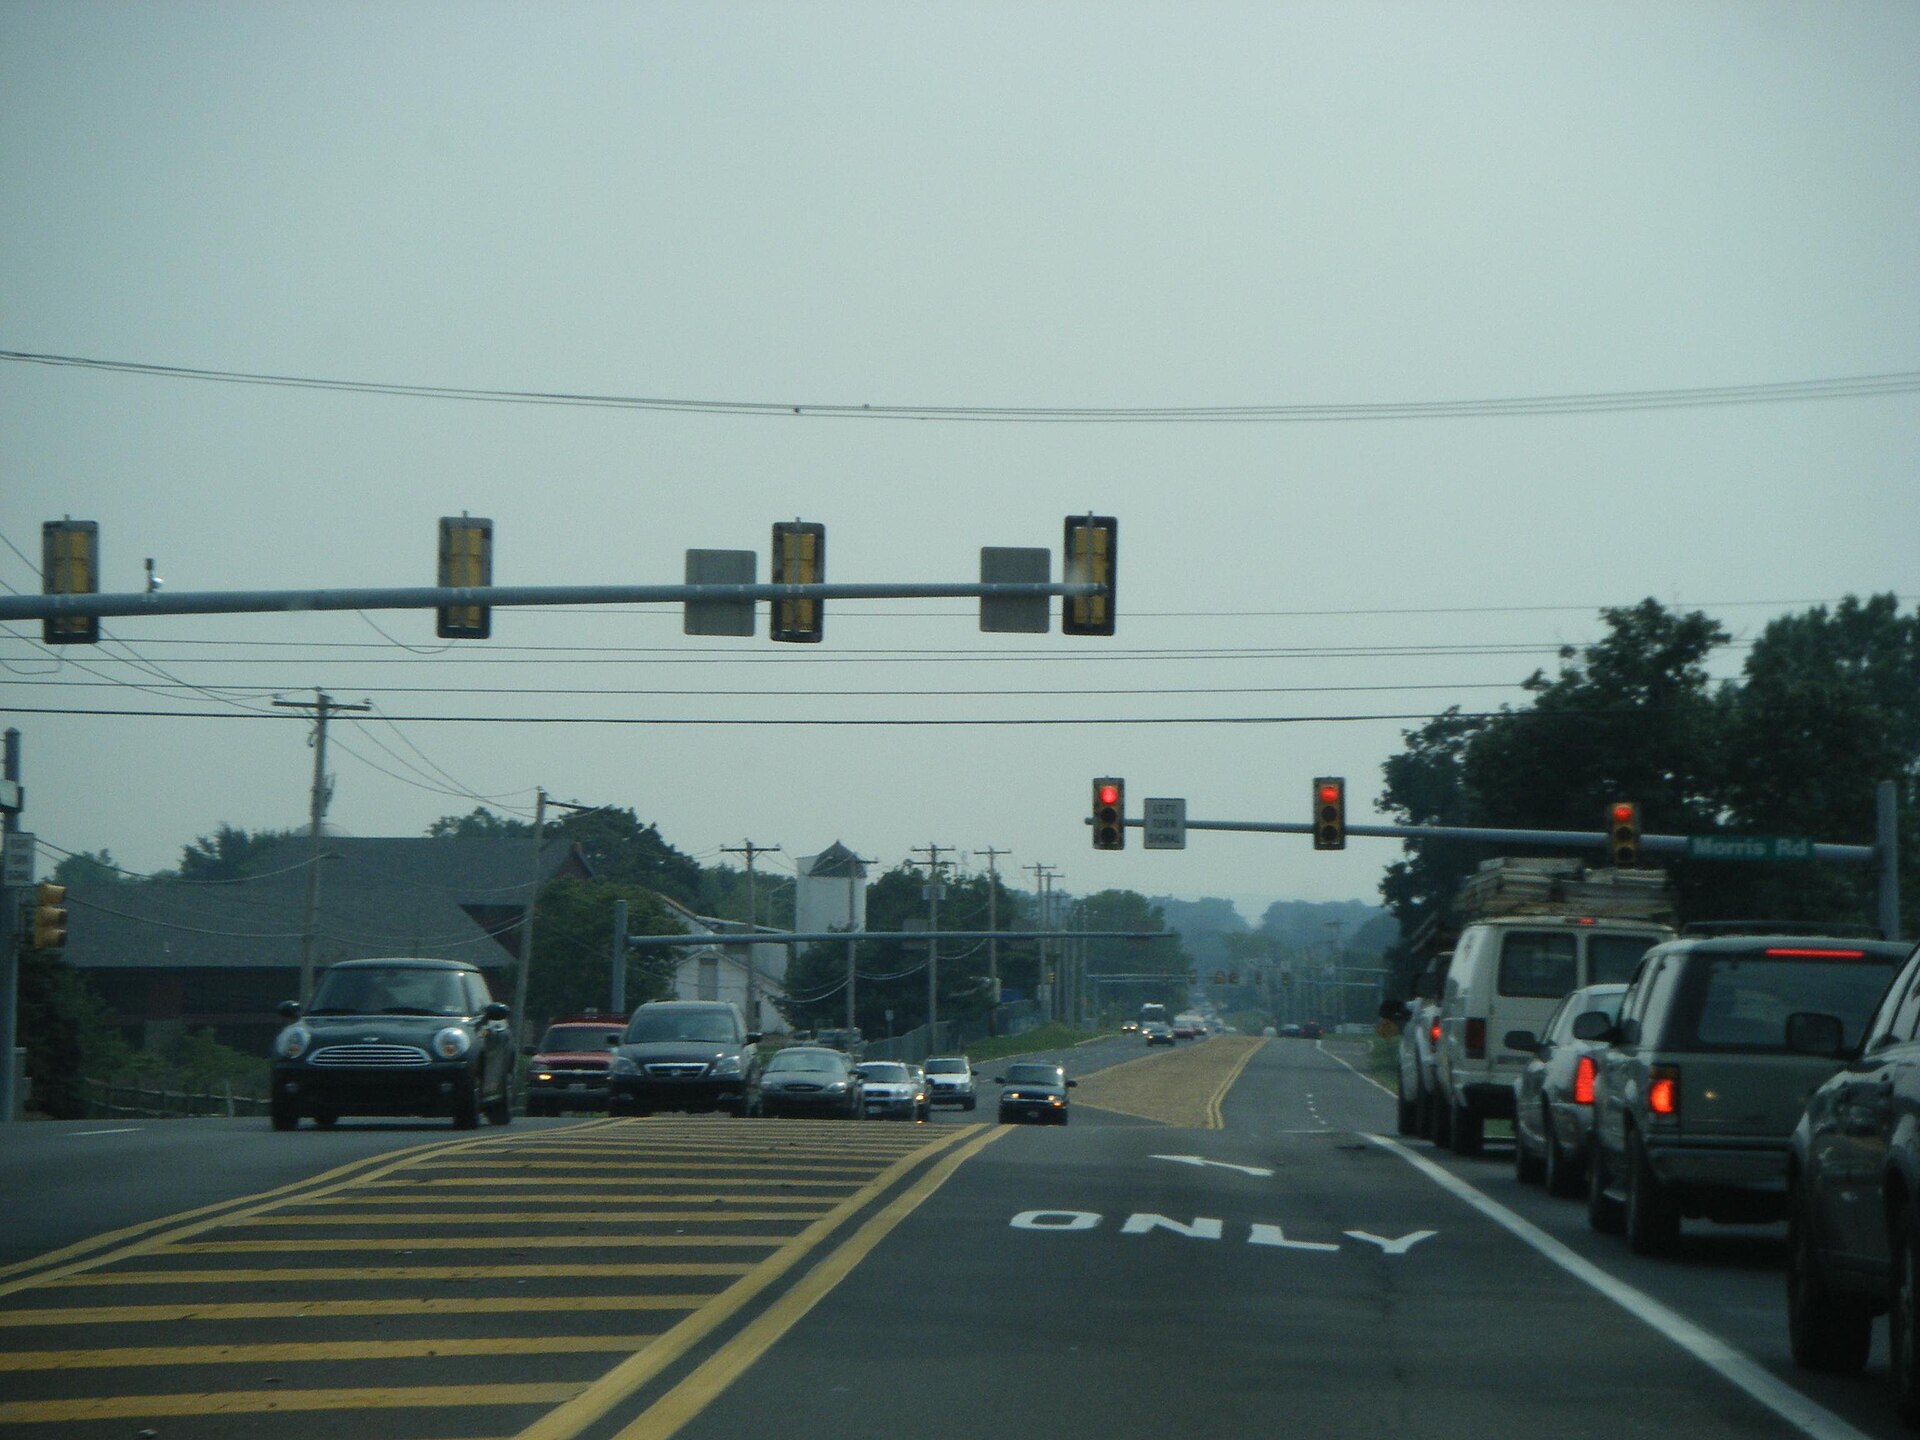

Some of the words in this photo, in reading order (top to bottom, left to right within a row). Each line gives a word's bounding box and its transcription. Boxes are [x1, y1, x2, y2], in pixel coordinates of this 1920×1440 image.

[1152, 804, 1177, 814] LEFT
[1152, 819, 1177, 829] TURN
[1148, 833, 1181, 844] SIGNAL
[1693, 838, 1767, 855] Morris
[1776, 838, 1807, 856] Rd
[1008, 1209, 1439, 1254] ONLY
